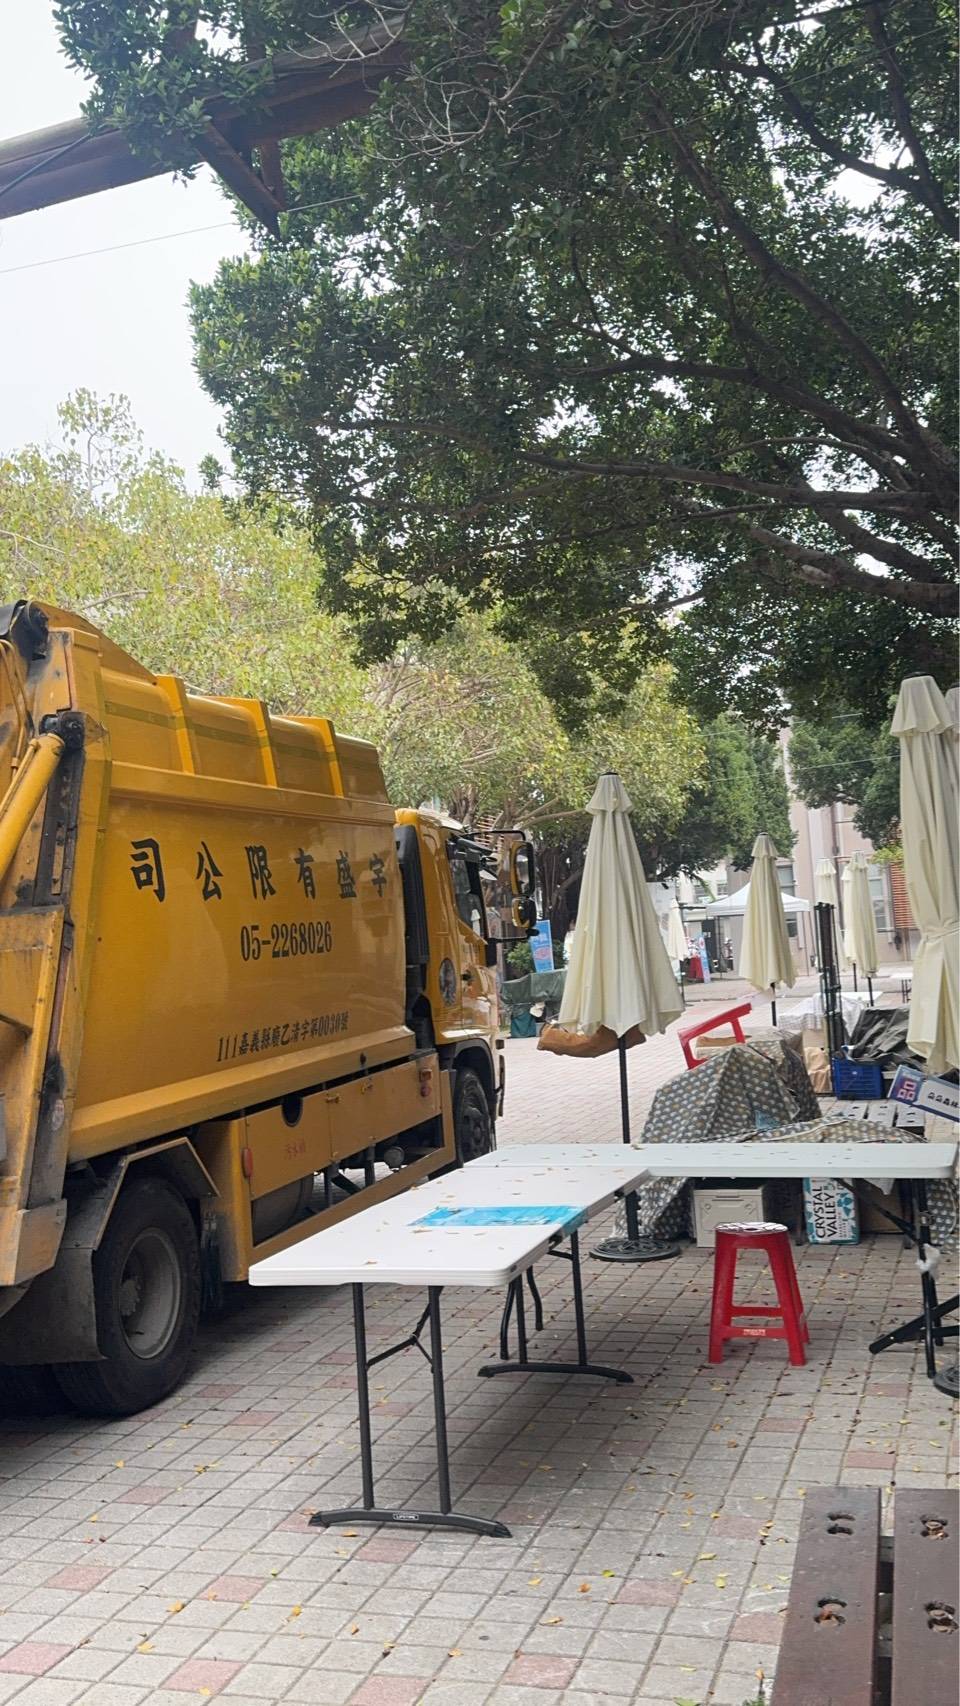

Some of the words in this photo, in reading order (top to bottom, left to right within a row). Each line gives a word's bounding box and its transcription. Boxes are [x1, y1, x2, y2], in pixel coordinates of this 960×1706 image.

[240, 921, 333, 962] 05-2268026
[812, 1185, 826, 1239] CRYSTAL
[823, 1192, 838, 1238] VALLEY
